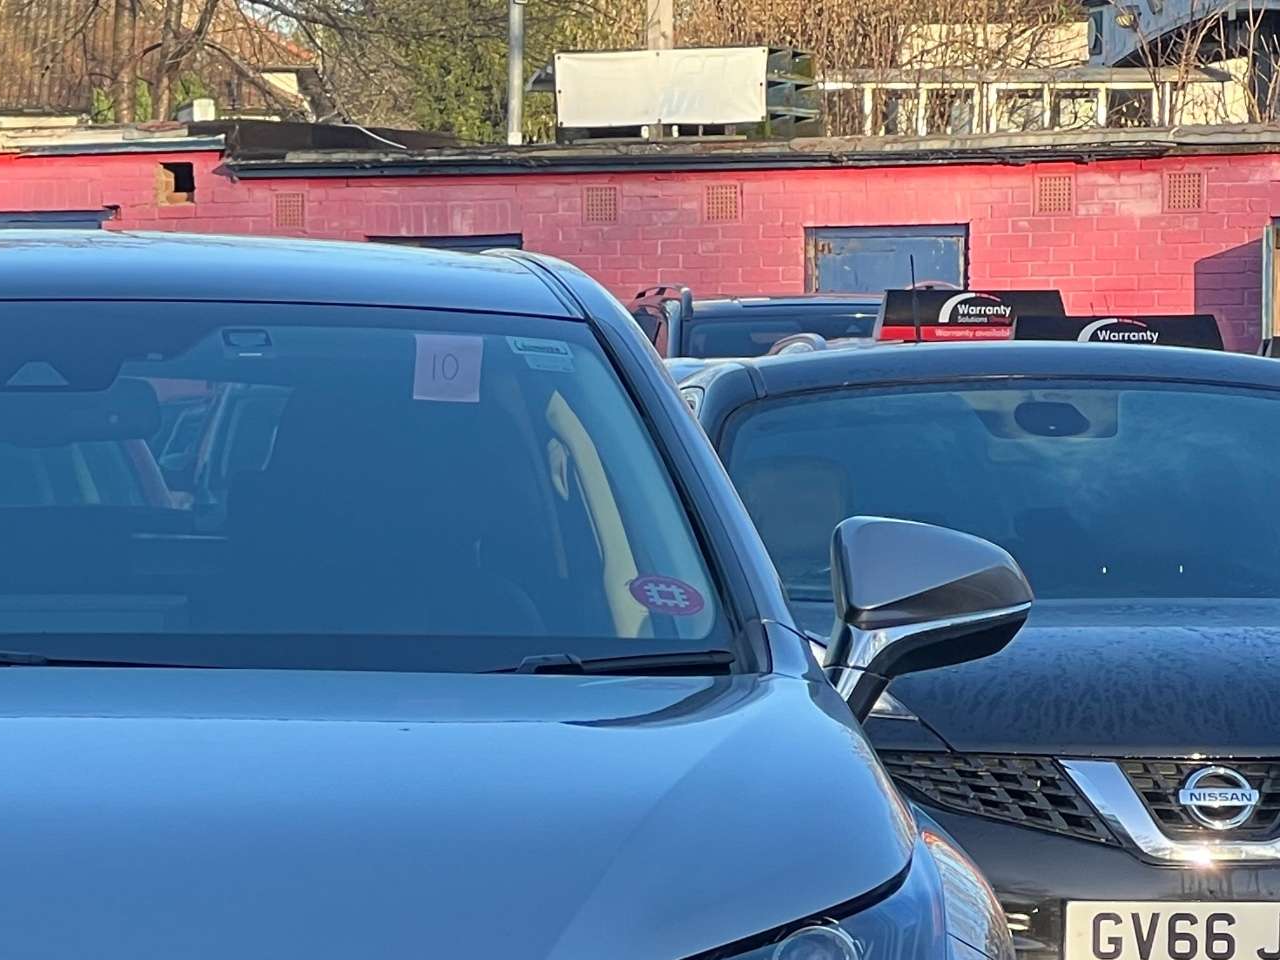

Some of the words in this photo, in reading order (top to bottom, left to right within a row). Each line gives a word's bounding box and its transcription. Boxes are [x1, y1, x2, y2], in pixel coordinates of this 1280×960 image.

[957, 304, 1012, 317] Warranty
[957, 315, 988, 323] Solutions
[935, 328, 974, 338] Warranty
[1097, 330, 1159, 343] Warranty
[432, 353, 459, 381] 10
[1189, 792, 1252, 802] NISSAN
[1092, 912, 1236, 960] GV66
